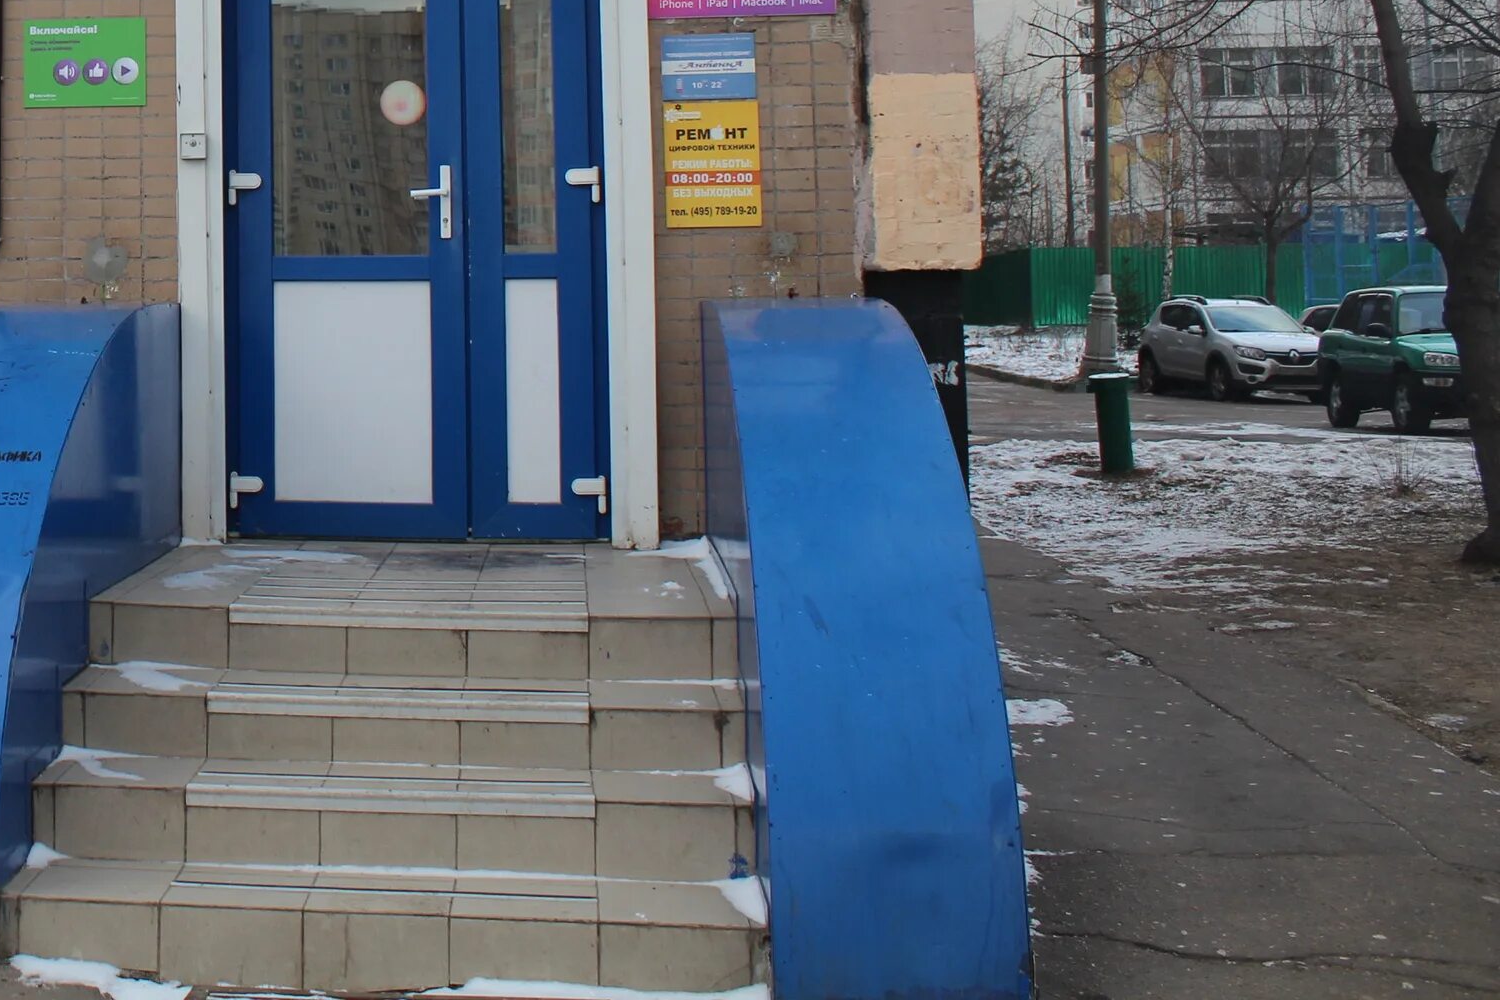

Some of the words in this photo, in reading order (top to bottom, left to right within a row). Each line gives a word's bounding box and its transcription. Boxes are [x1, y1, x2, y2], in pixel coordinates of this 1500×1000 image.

[659, 0, 694, 10] iPhone
[29, 25, 98, 36] Включайся!
[668, 144, 715, 152] ЦИФРОВОЙ
[717, 143, 756, 151] ТЕХНИКИ
[671, 159, 708, 169] РЕЖИМ
[710, 158, 753, 169] РАБОТЫ:
[672, 188, 692, 198] БЕЗ
[694, 187, 754, 198] ВЫХОДНЫХ
[670, 208, 689, 217] тел.
[690, 206, 713, 218] (495)
[715, 205, 758, 216] 789-19-20
